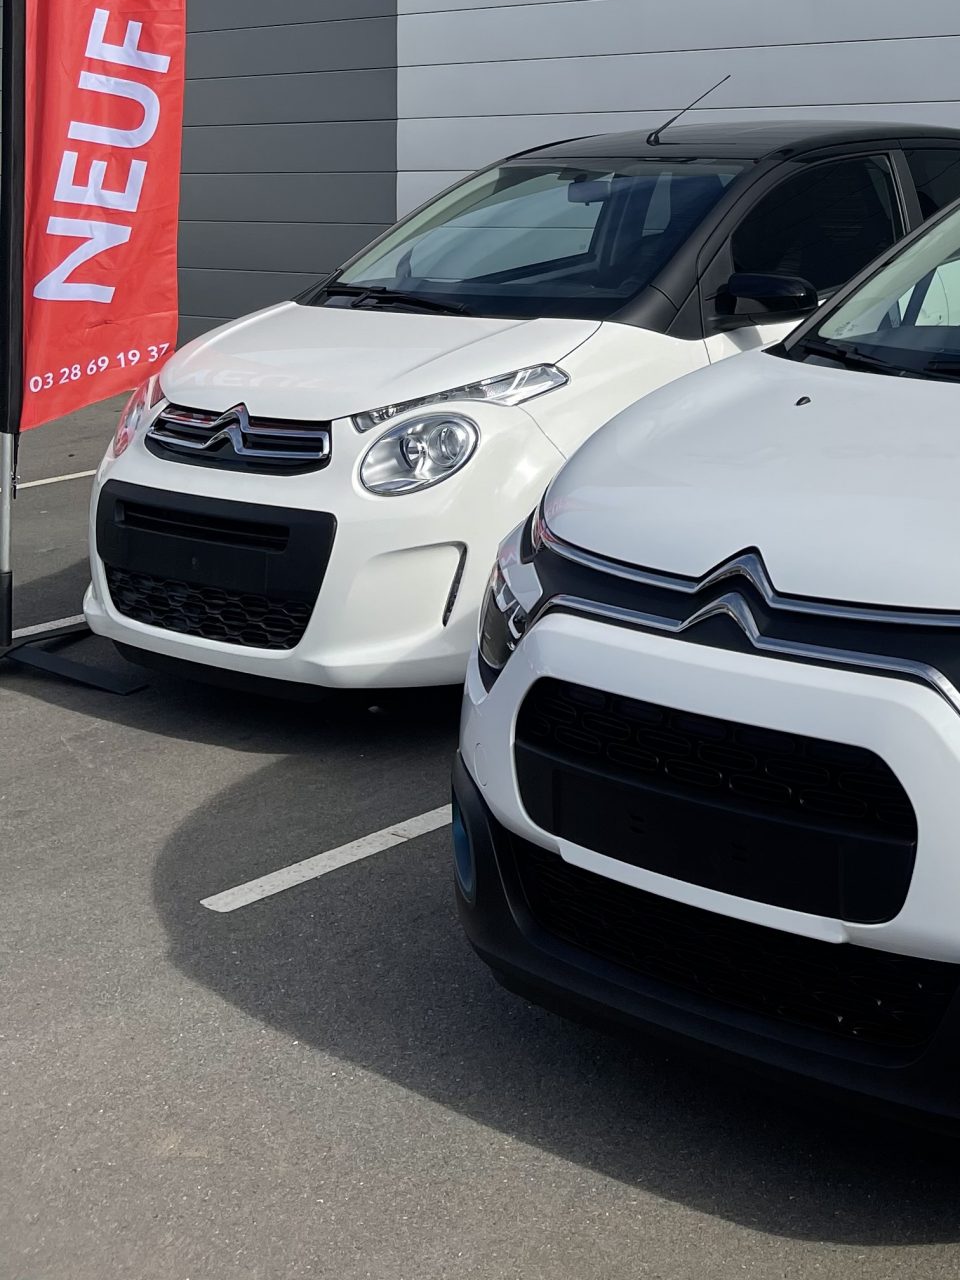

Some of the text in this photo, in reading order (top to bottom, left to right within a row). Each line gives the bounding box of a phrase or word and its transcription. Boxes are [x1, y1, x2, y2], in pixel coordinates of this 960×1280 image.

[33, 7, 171, 304] NEUF
[29, 342, 170, 393] 03 28 69 19 37
